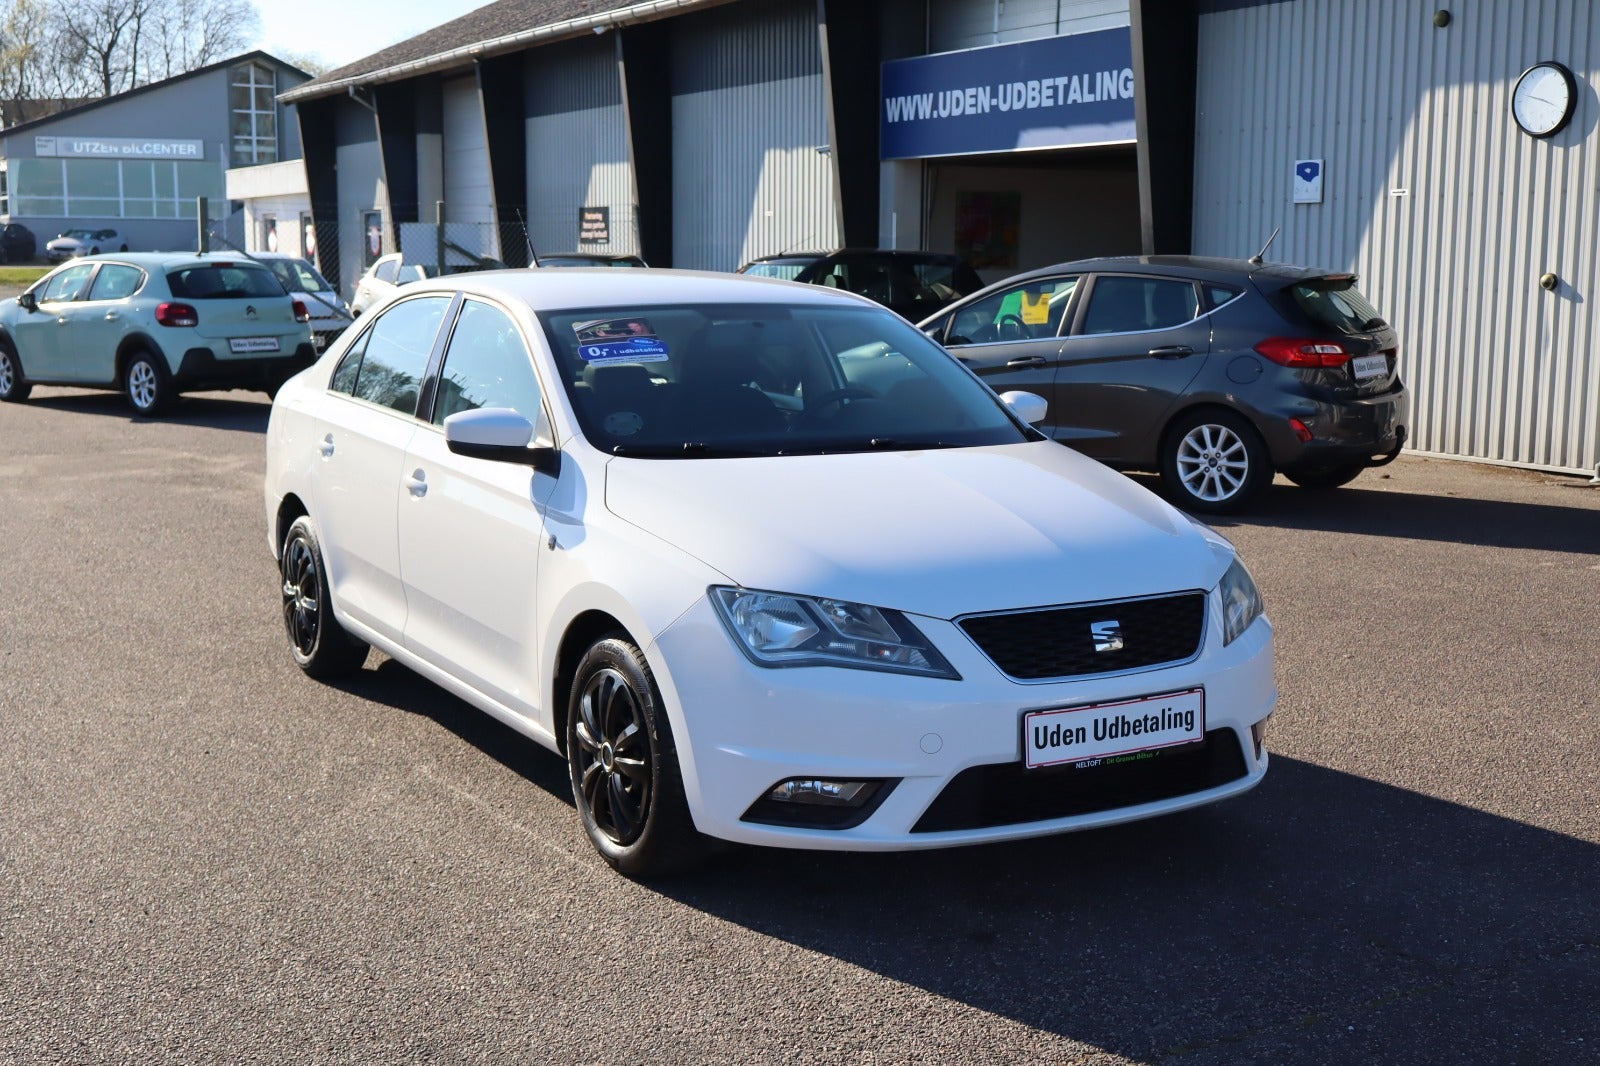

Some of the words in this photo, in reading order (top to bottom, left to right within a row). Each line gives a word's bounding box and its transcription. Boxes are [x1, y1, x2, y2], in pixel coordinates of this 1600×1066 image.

[886, 68, 1134, 123] WWW.UDEN-UDBETALING
[619, 346, 664, 355] udbetaling
[1034, 723, 1086, 750] Uden
[1093, 707, 1195, 742] Udbetaling
[1075, 759, 1102, 769] NELTOFT
